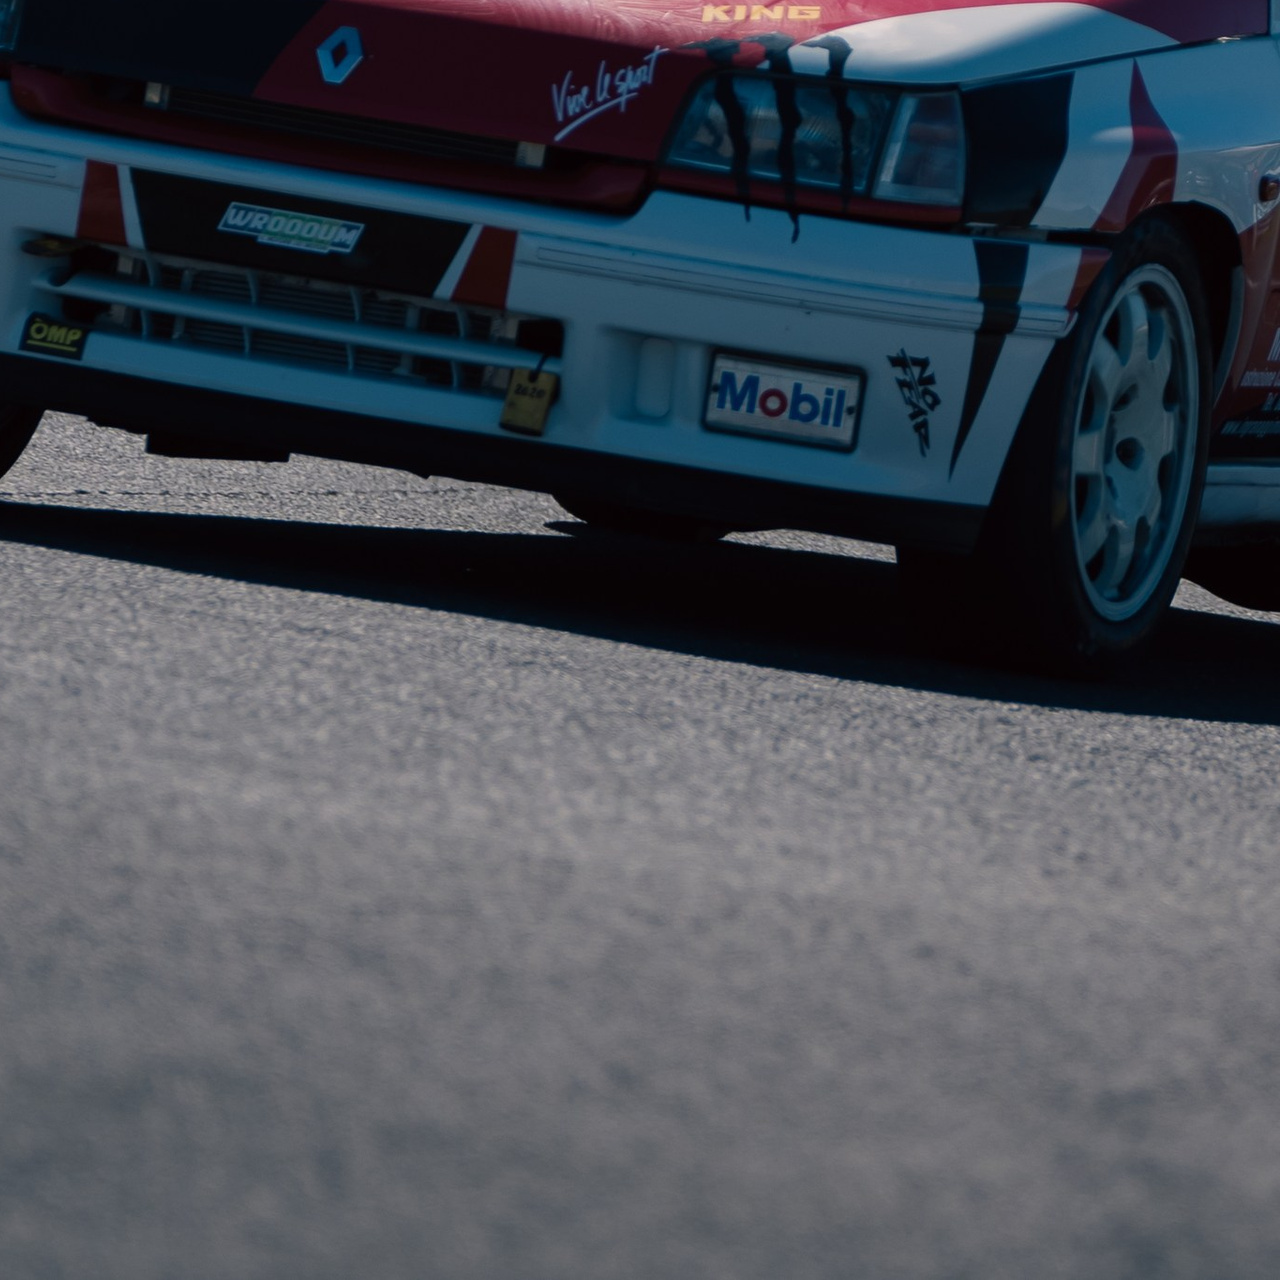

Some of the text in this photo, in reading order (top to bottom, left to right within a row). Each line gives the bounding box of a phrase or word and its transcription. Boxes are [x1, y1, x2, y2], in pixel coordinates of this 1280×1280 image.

[702, 4, 822, 22] KING
[552, 45, 670, 122] Vive le sport
[29, 319, 82, 345] OMP
[716, 371, 846, 427] Mobil
